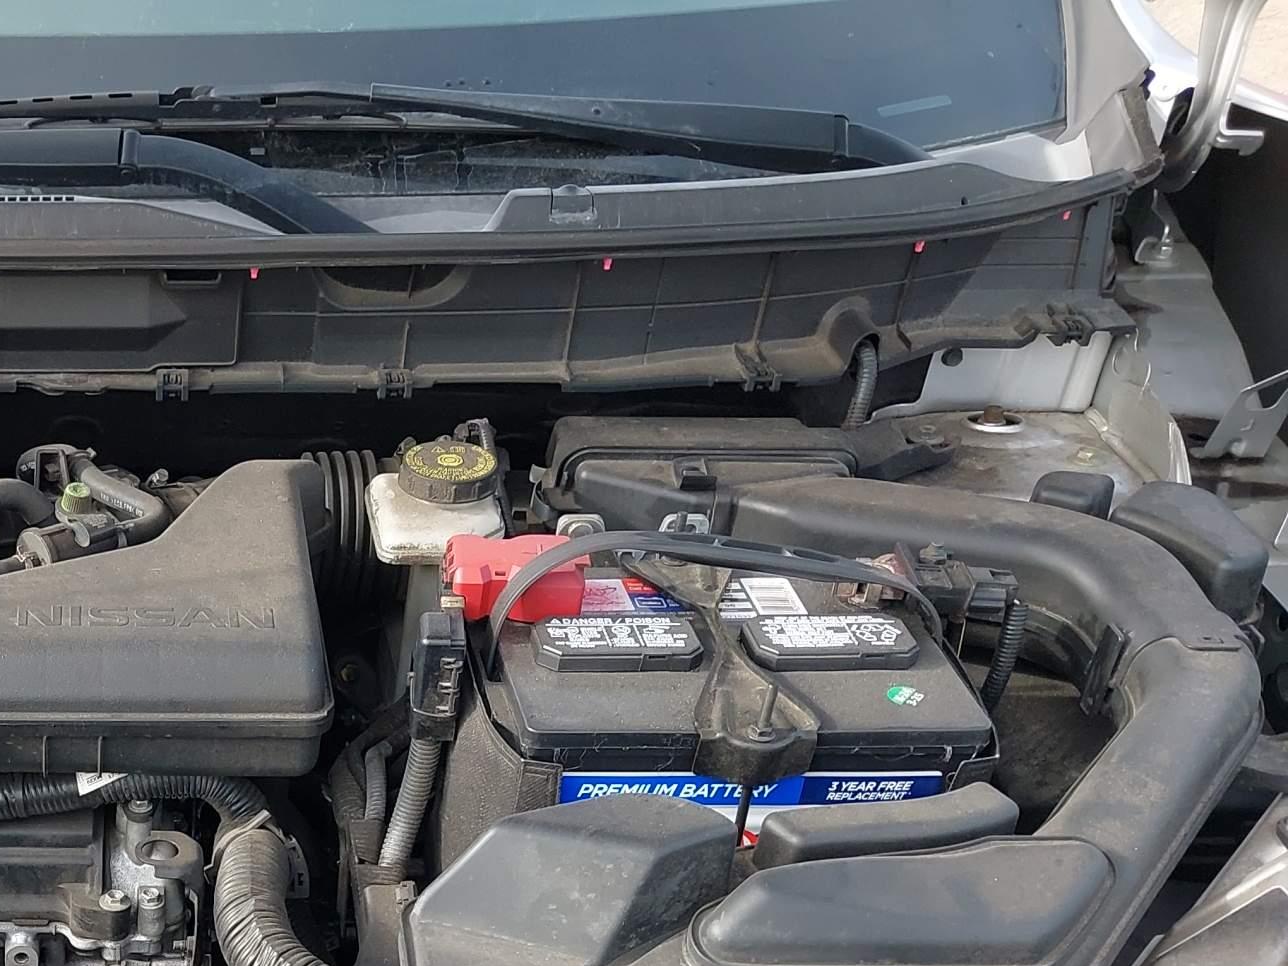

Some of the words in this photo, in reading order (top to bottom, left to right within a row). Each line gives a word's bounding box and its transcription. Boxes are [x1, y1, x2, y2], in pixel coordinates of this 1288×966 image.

[14, 604, 277, 630] NISSAN
[562, 617, 612, 625] DANGER
[577, 783, 677, 797] PREMIUM
[828, 781, 839, 791] 3
[841, 781, 877, 791] YEAR
[877, 781, 914, 791] FREE
